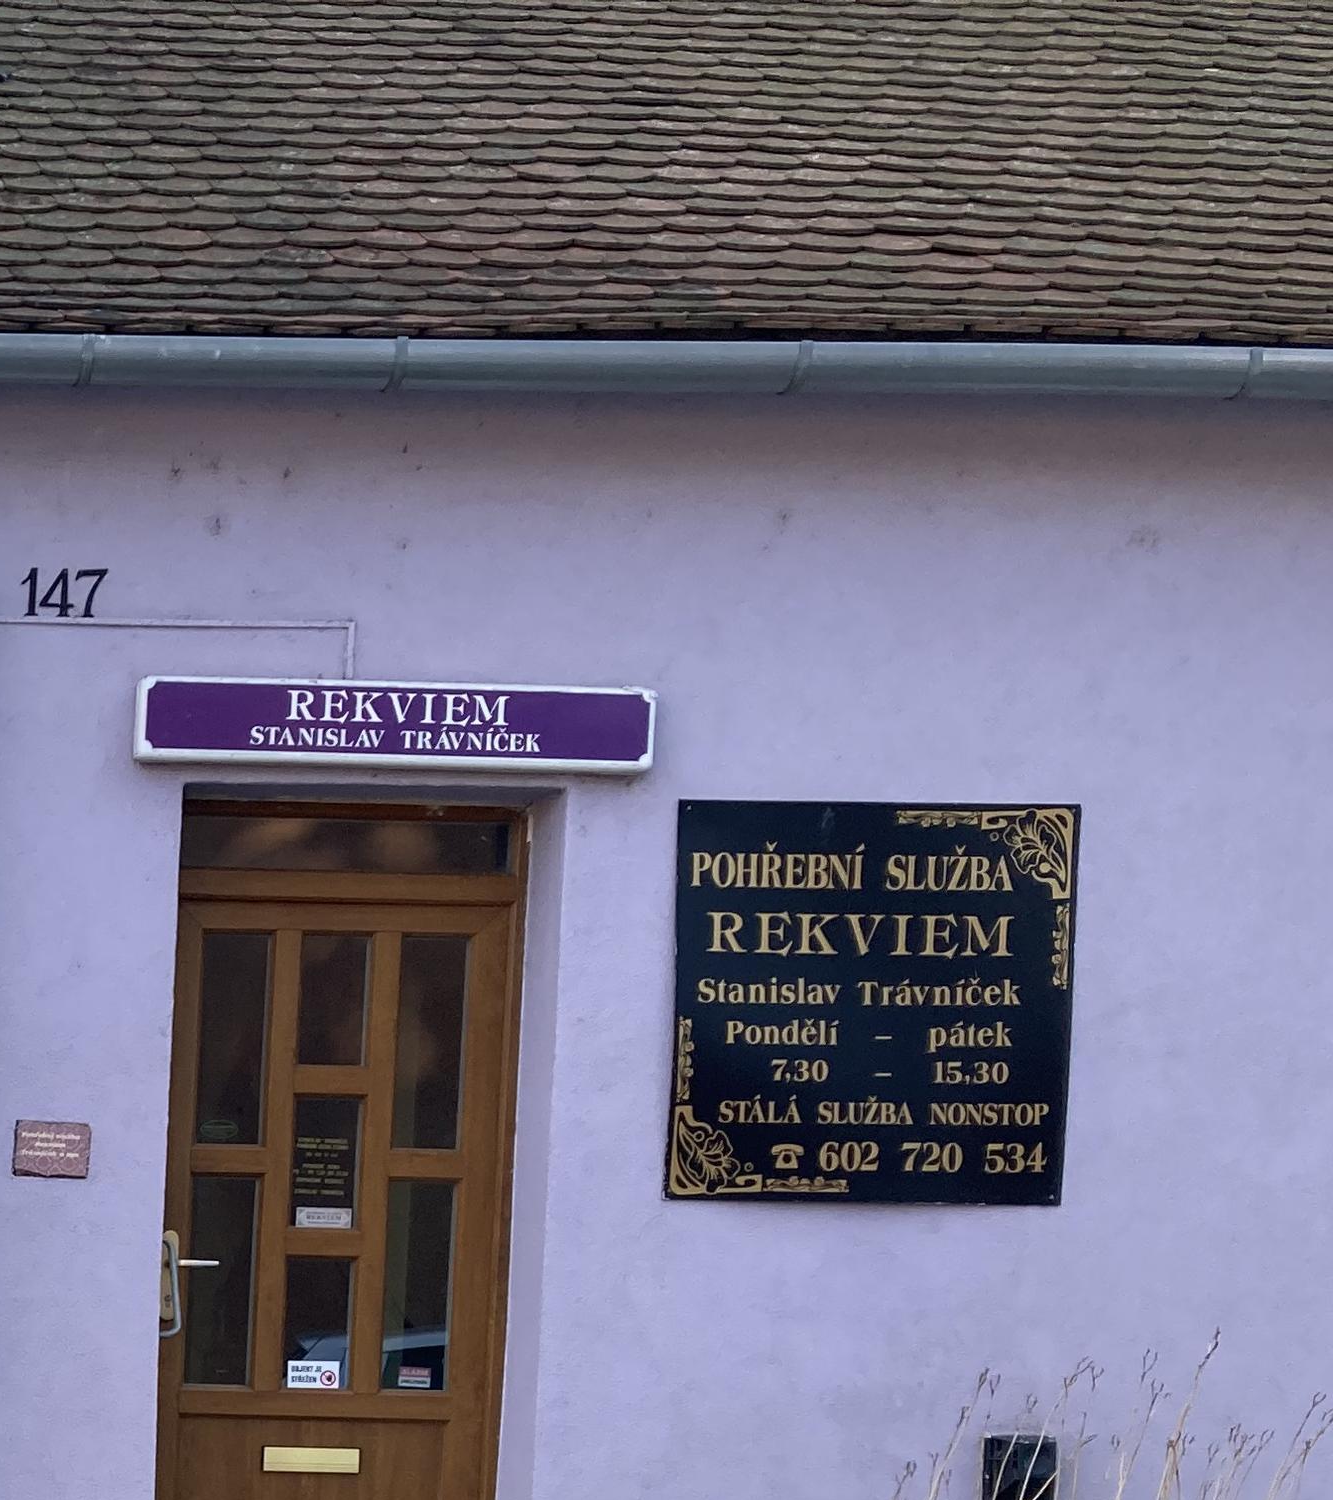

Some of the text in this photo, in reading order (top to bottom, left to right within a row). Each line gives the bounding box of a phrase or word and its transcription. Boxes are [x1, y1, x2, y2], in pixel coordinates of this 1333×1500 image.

[20, 567, 109, 618] 147
[286, 688, 511, 727] REKVIEM
[249, 725, 541, 753] STANISLAV TRÁVNÍČEK
[690, 841, 1014, 892] POHŘEBNÍ SLUŽBA
[706, 911, 1015, 960] REKVIEM
[697, 978, 1021, 1006] Stanislav Trávníček
[725, 1019, 839, 1046] Pondělí
[926, 1021, 1012, 1053] pátek
[718, 1094, 1049, 1126] STÁLÁ SLUŽBA NONSTOP
[819, 1141, 1047, 1173] 602 720 534
